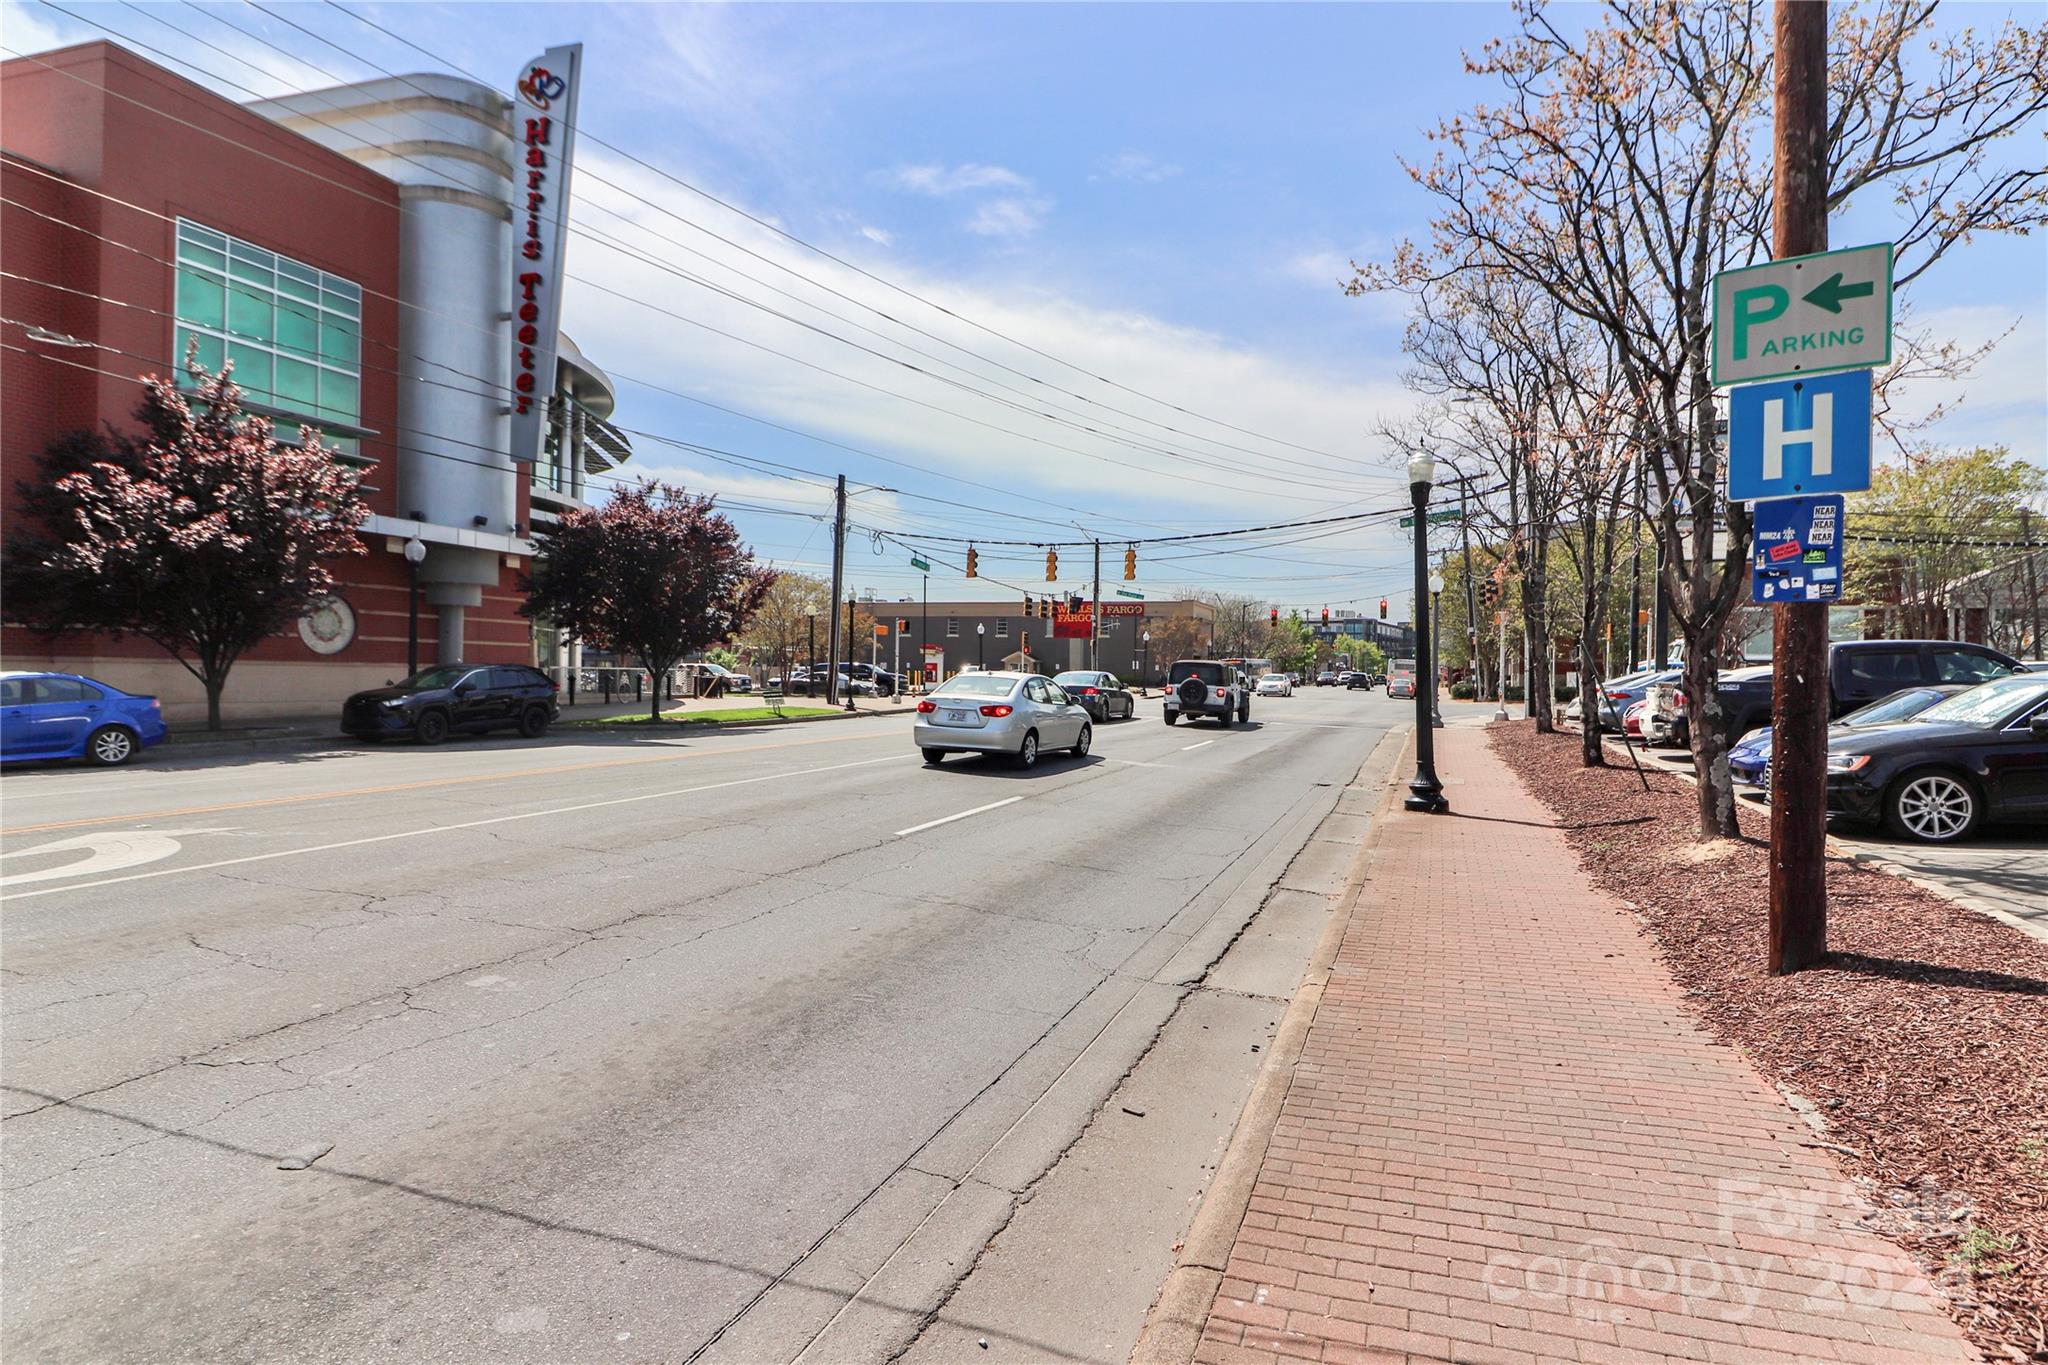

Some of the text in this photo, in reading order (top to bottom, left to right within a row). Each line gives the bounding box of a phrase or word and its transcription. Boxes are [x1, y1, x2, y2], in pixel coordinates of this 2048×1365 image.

[515, 116, 551, 415] Harris Teeter
[1763, 392, 1833, 480] H
[1815, 507, 1835, 515] NEAR
[1814, 521, 1834, 529] NEAR
[1812, 533, 1832, 541] NEAR
[1056, 604, 1092, 614] WLS
[1107, 605, 1143, 614] FARGO
[1056, 613, 1092, 622] FARGO
